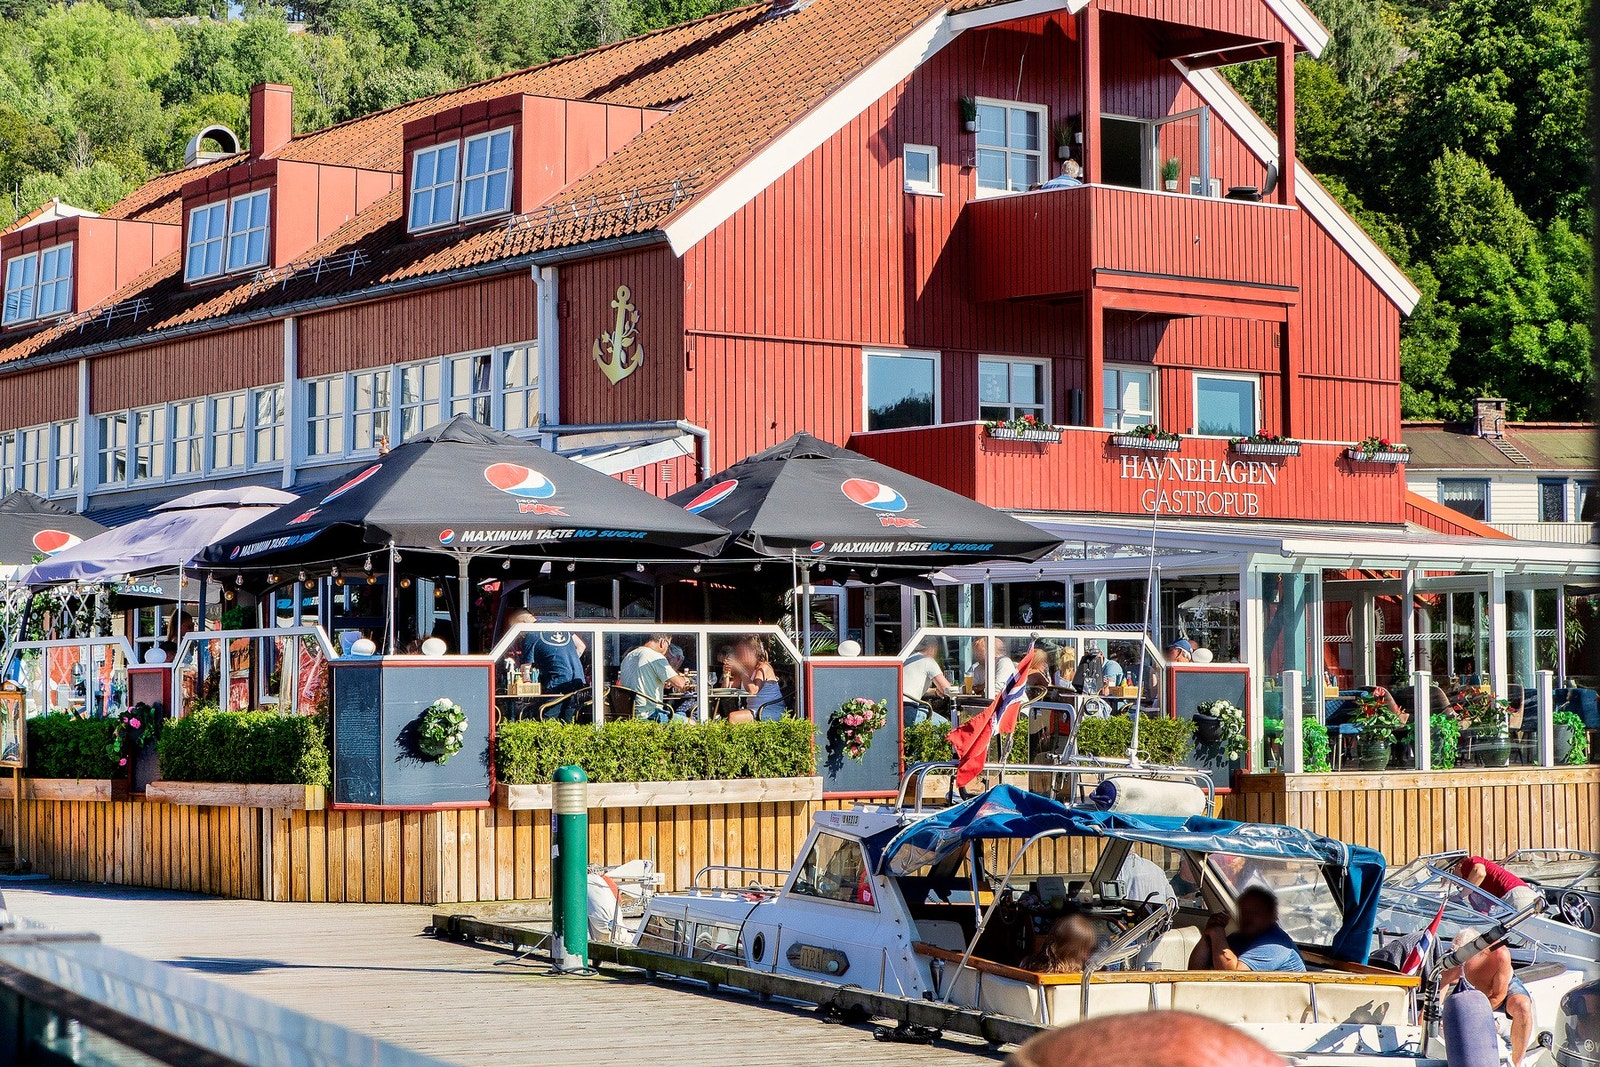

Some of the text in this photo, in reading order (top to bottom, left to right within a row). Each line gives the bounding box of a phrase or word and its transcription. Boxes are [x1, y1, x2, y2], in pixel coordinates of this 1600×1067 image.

[1120, 454, 1277, 485] HAVNEHAGEN
[1141, 489, 1259, 516] GASTROPUB
[518, 503, 570, 517] MAX
[878, 516, 927, 529] MAX
[461, 529, 648, 542] MAXIMUM TASTE NO SUGAR
[829, 542, 995, 553] MAXIMUM TASTE NO SUGAR
[126, 585, 163, 595] UGAR
